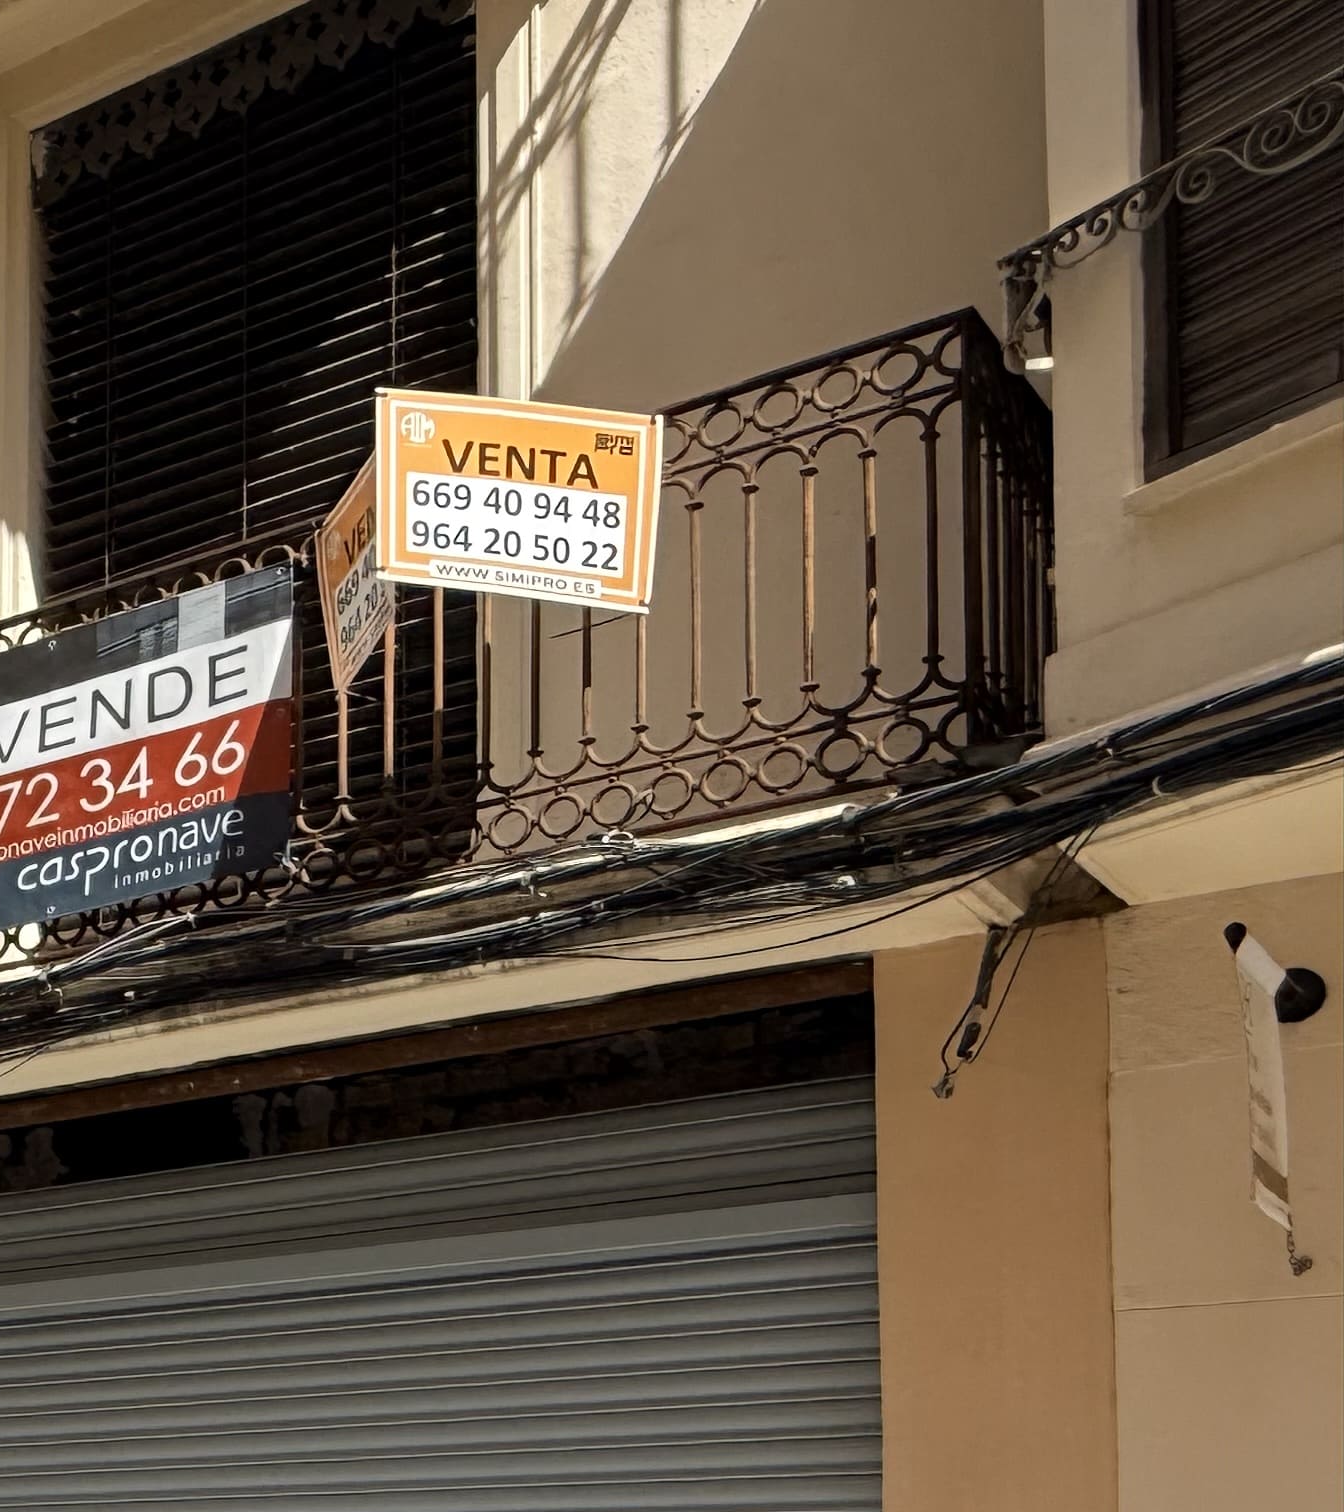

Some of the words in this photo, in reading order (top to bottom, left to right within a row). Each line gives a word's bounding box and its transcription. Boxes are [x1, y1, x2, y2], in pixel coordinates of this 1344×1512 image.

[441, 438, 599, 490] VENTA
[412, 479, 472, 510] 669
[483, 487, 522, 516] 40
[533, 492, 573, 523] 94
[581, 499, 621, 529] 48
[411, 520, 472, 552] 964
[483, 527, 522, 557] 20
[532, 535, 571, 564] 50
[581, 541, 619, 571] 22
[78, 746, 154, 812] 34
[174, 719, 246, 787] 66
[16, 807, 244, 897] caspronave
[114, 844, 246, 889] inmobiliaria
